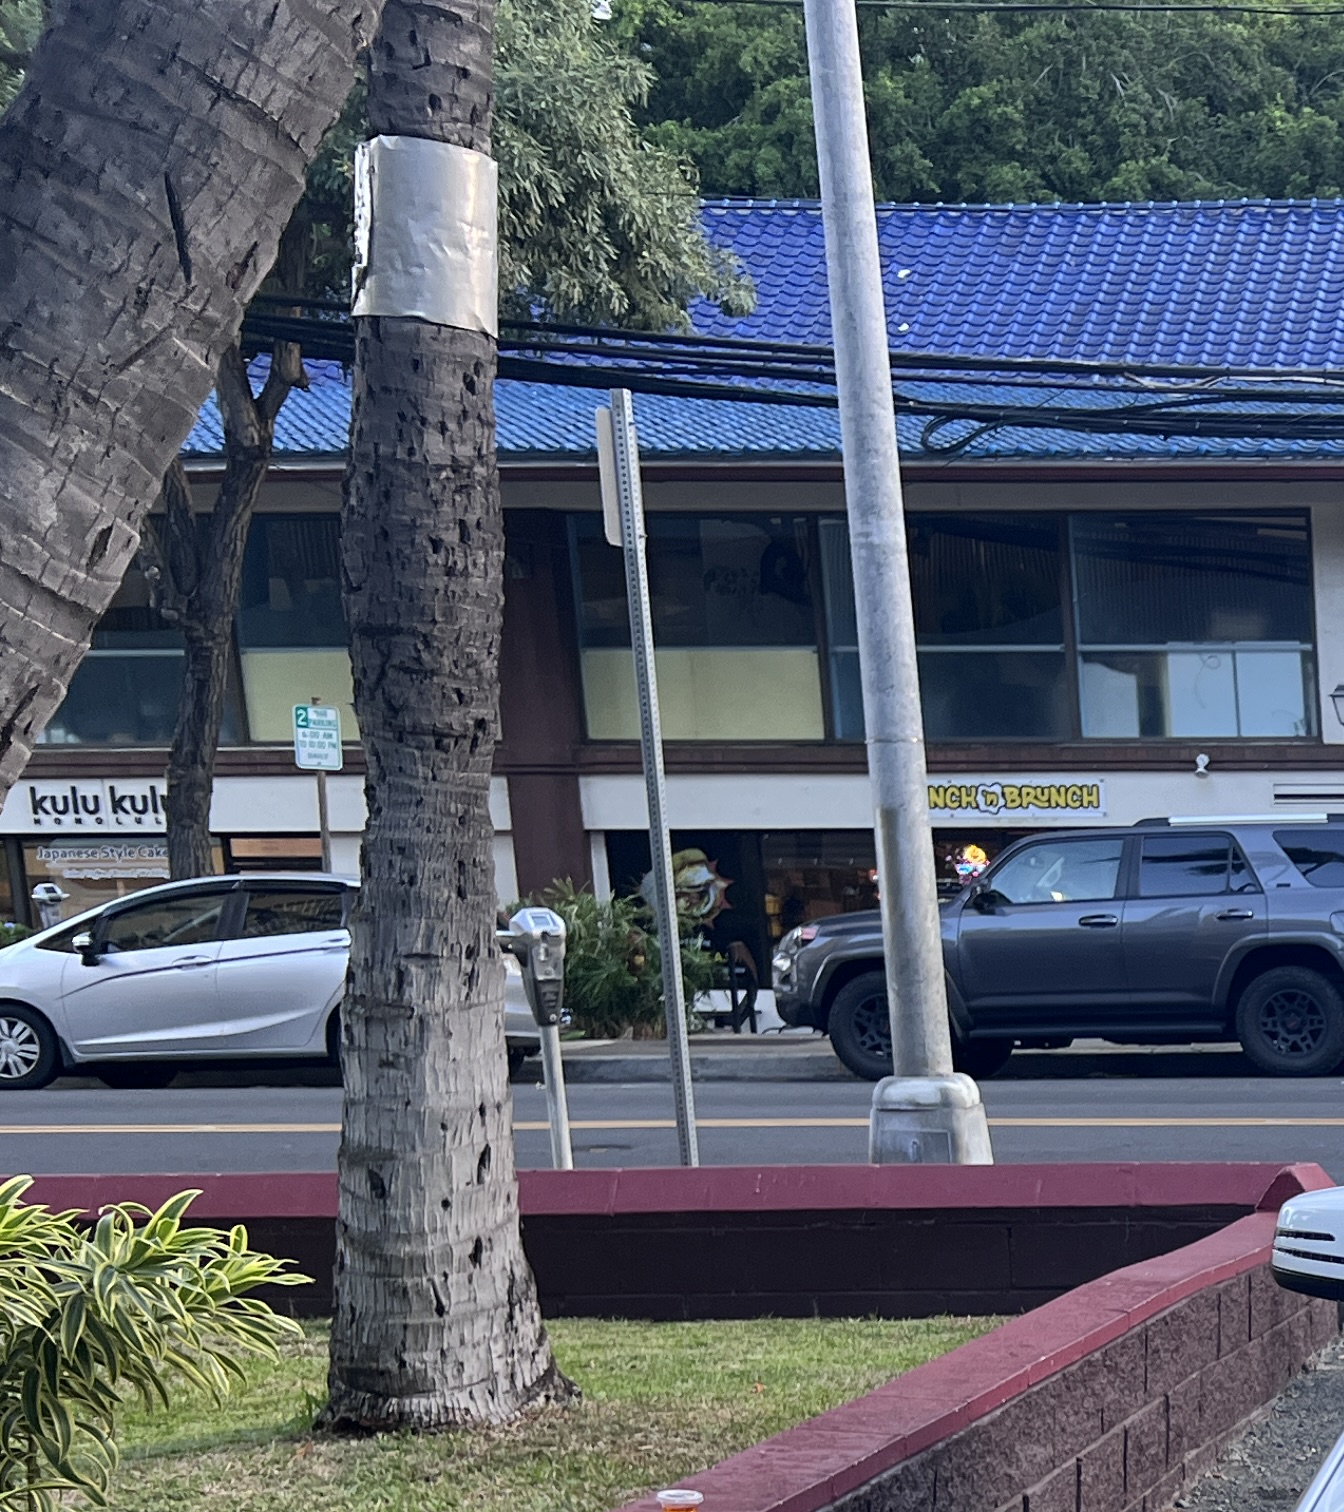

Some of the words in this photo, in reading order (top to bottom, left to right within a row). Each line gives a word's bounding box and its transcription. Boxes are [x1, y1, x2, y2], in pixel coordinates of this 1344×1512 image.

[297, 709, 307, 725] 2
[29, 785, 100, 816] kulu
[1002, 783, 1099, 810] BRUNCH
[37, 846, 98, 862] Japanese
[101, 846, 135, 862] Style
